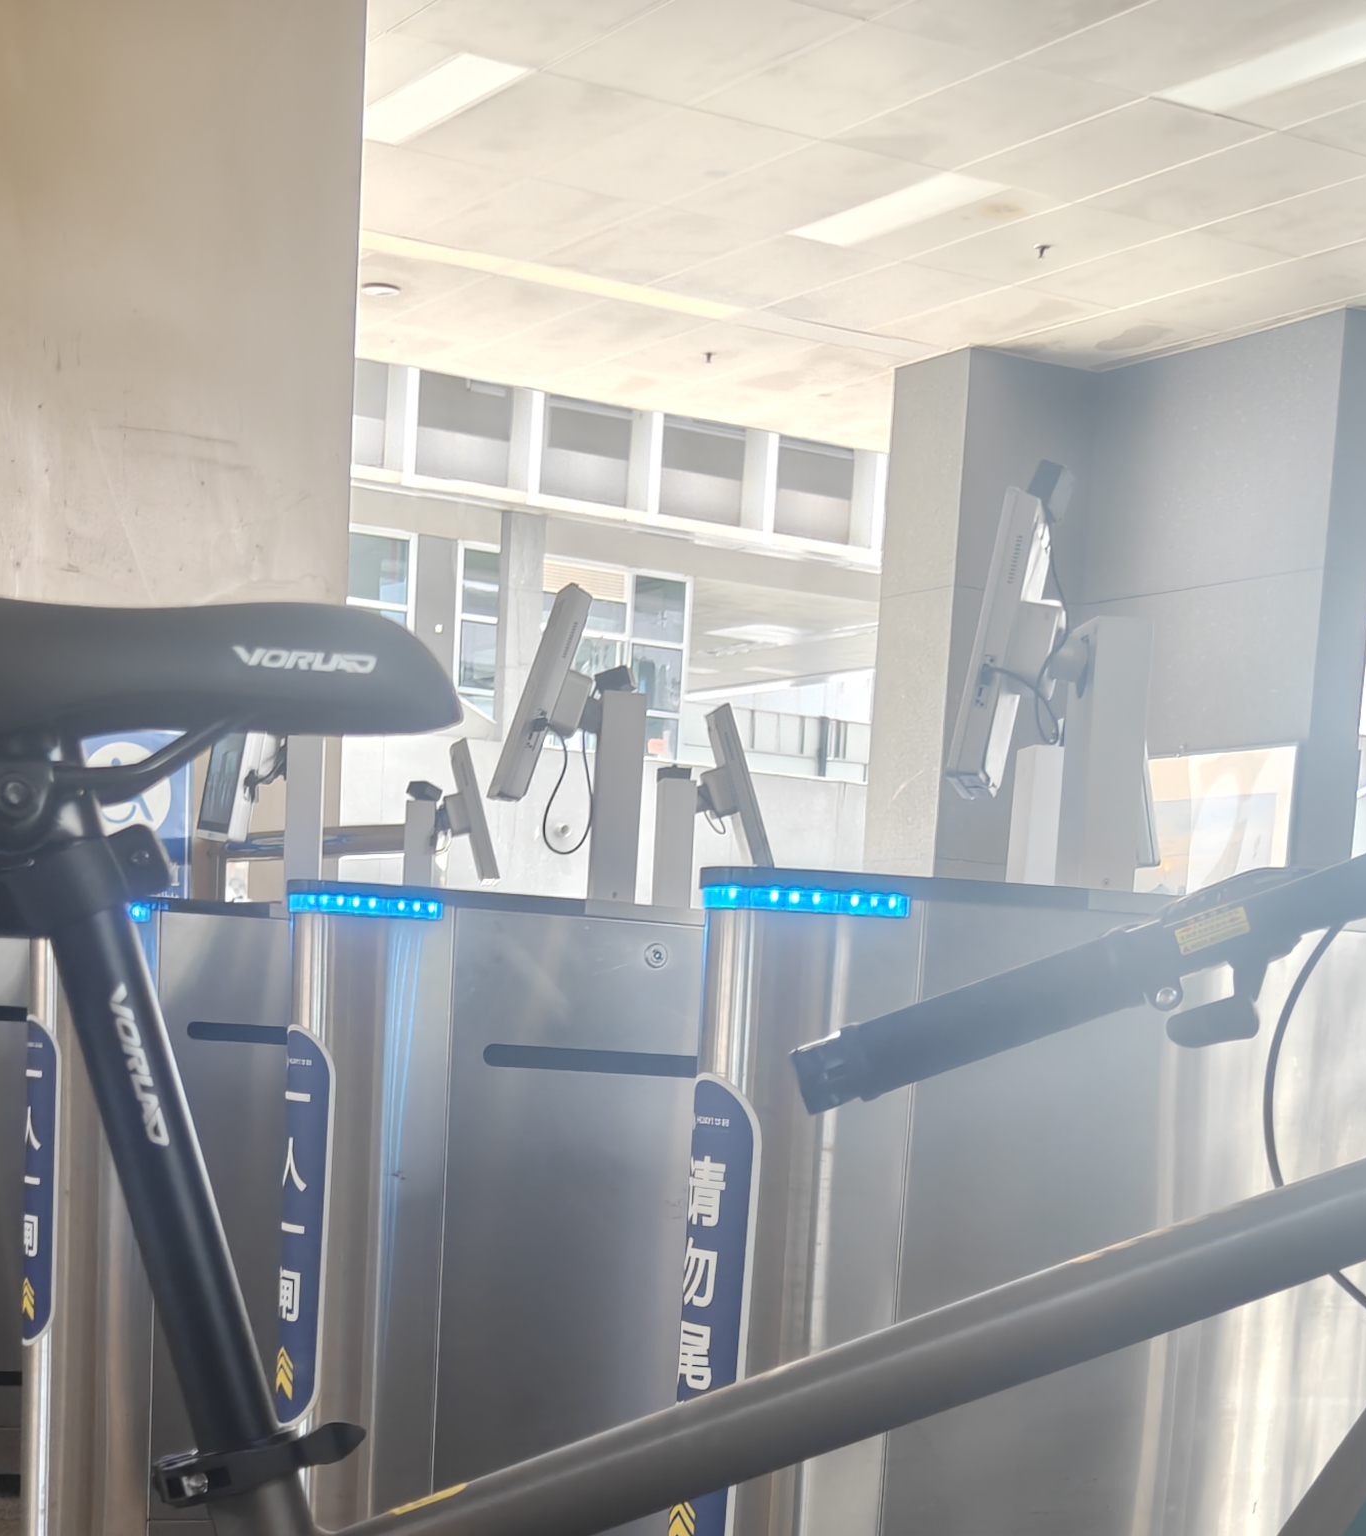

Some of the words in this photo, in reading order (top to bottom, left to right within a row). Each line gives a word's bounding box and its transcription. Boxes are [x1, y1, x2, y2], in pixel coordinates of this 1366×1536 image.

[232, 645, 377, 674] VORLAD
[110, 981, 171, 1147] VORLAD
[677, 1155, 727, 1392] 请勿尾
